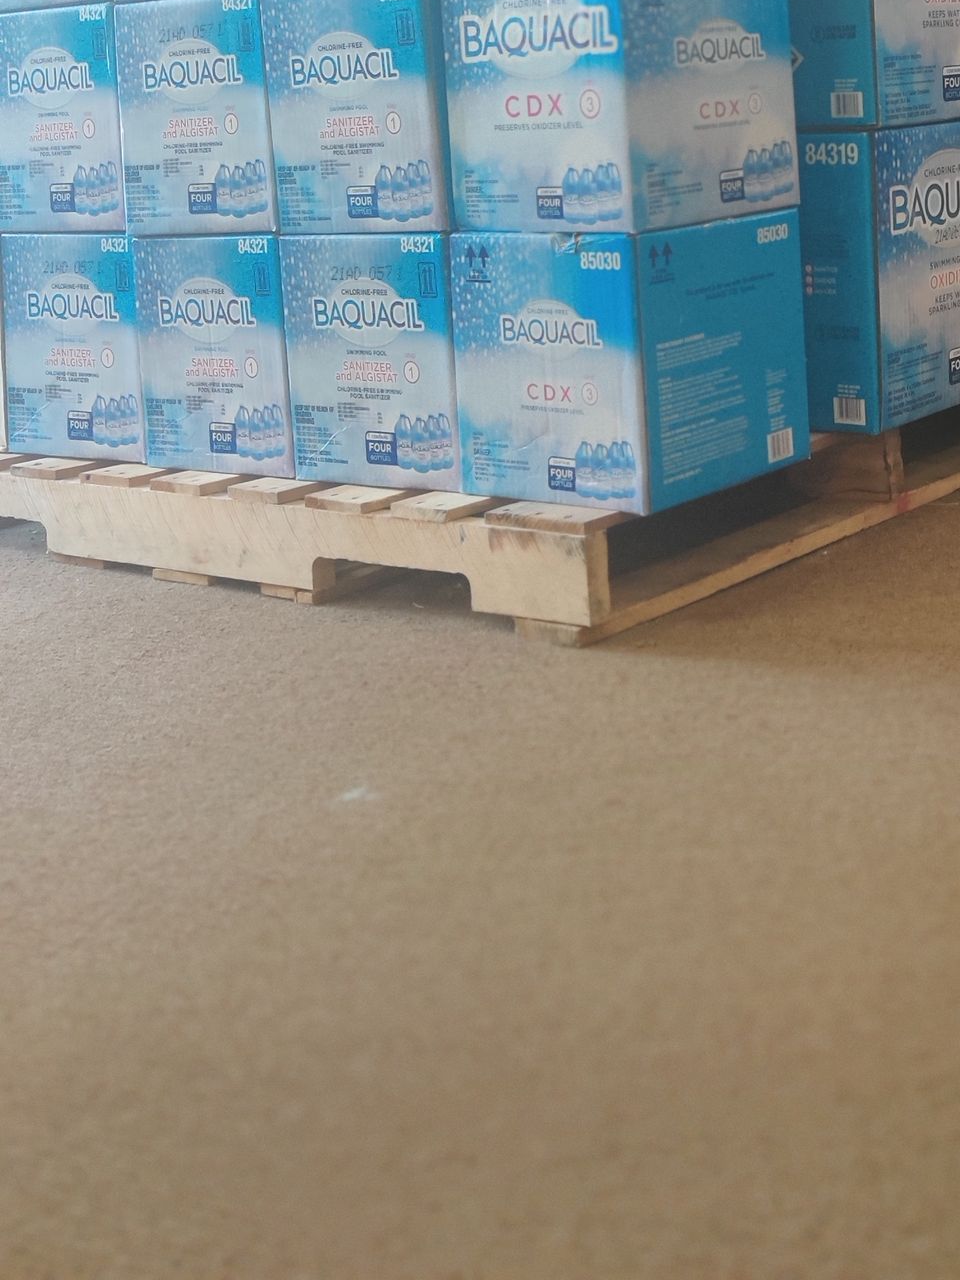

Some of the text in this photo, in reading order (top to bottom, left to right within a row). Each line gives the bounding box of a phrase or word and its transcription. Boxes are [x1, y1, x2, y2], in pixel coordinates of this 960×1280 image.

[79, 6, 106, 21] 84321
[928, 10, 945, 18] KEEPS
[923, 19, 954, 28] SPARKLING
[463, 10, 613, 59] BAQUACIL
[318, 42, 363, 52] CHLORINE-FREE
[676, 36, 764, 64] BAQUACIL
[144, 58, 241, 89] BAQUACIL
[292, 51, 398, 86] BAQUACIL
[8, 65, 92, 95] BAQUACIL
[505, 93, 563, 118] CDX
[700, 100, 740, 119] CDX
[35, 122, 73, 132] SANITIZER
[169, 117, 213, 129] SANITIZER
[326, 116, 374, 128] SANITIZER
[494, 121, 583, 132] PRESERVES OXIDIZER LEVEL
[45, 131, 78, 141] ALGISTAT
[162, 127, 219, 139] and ALGISTAT
[320, 126, 380, 139] and ALGISTAT
[806, 143, 859, 165] 84319
[53, 193, 71, 202] FOUR
[191, 193, 212, 203] FOUR
[350, 196, 373, 206] FOUR
[538, 198, 561, 209] FOUR
[757, 224, 788, 244] 85030
[101, 239, 128, 253] 84321
[238, 239, 268, 254] 84321
[400, 237, 435, 253] 84321
[580, 251, 621, 270] 85030
[930, 256, 960, 270] SWIMMING
[935, 292, 954, 304] KEEPS
[28, 293, 118, 320] BAQUACIL
[159, 299, 256, 326] BAQUACIL
[929, 300, 960, 316] SPARKLING
[313, 299, 422, 330] BAQUACIL
[502, 318, 601, 347] BAQUACIL
[51, 349, 91, 358] SANITIZER
[61, 358, 96, 368] ALGISTAT
[192, 357, 234, 368] SANITIZER
[343, 361, 393, 372] SANITIZER
[185, 368, 239, 378] and ALGISTAT
[336, 371, 398, 383] and ALGISTAT
[526, 383, 572, 403] CDX
[70, 422, 89, 430] FOUR
[212, 432, 232, 442] FOUR
[368, 442, 392, 453] FOUR
[550, 469, 573, 478] FOUR
